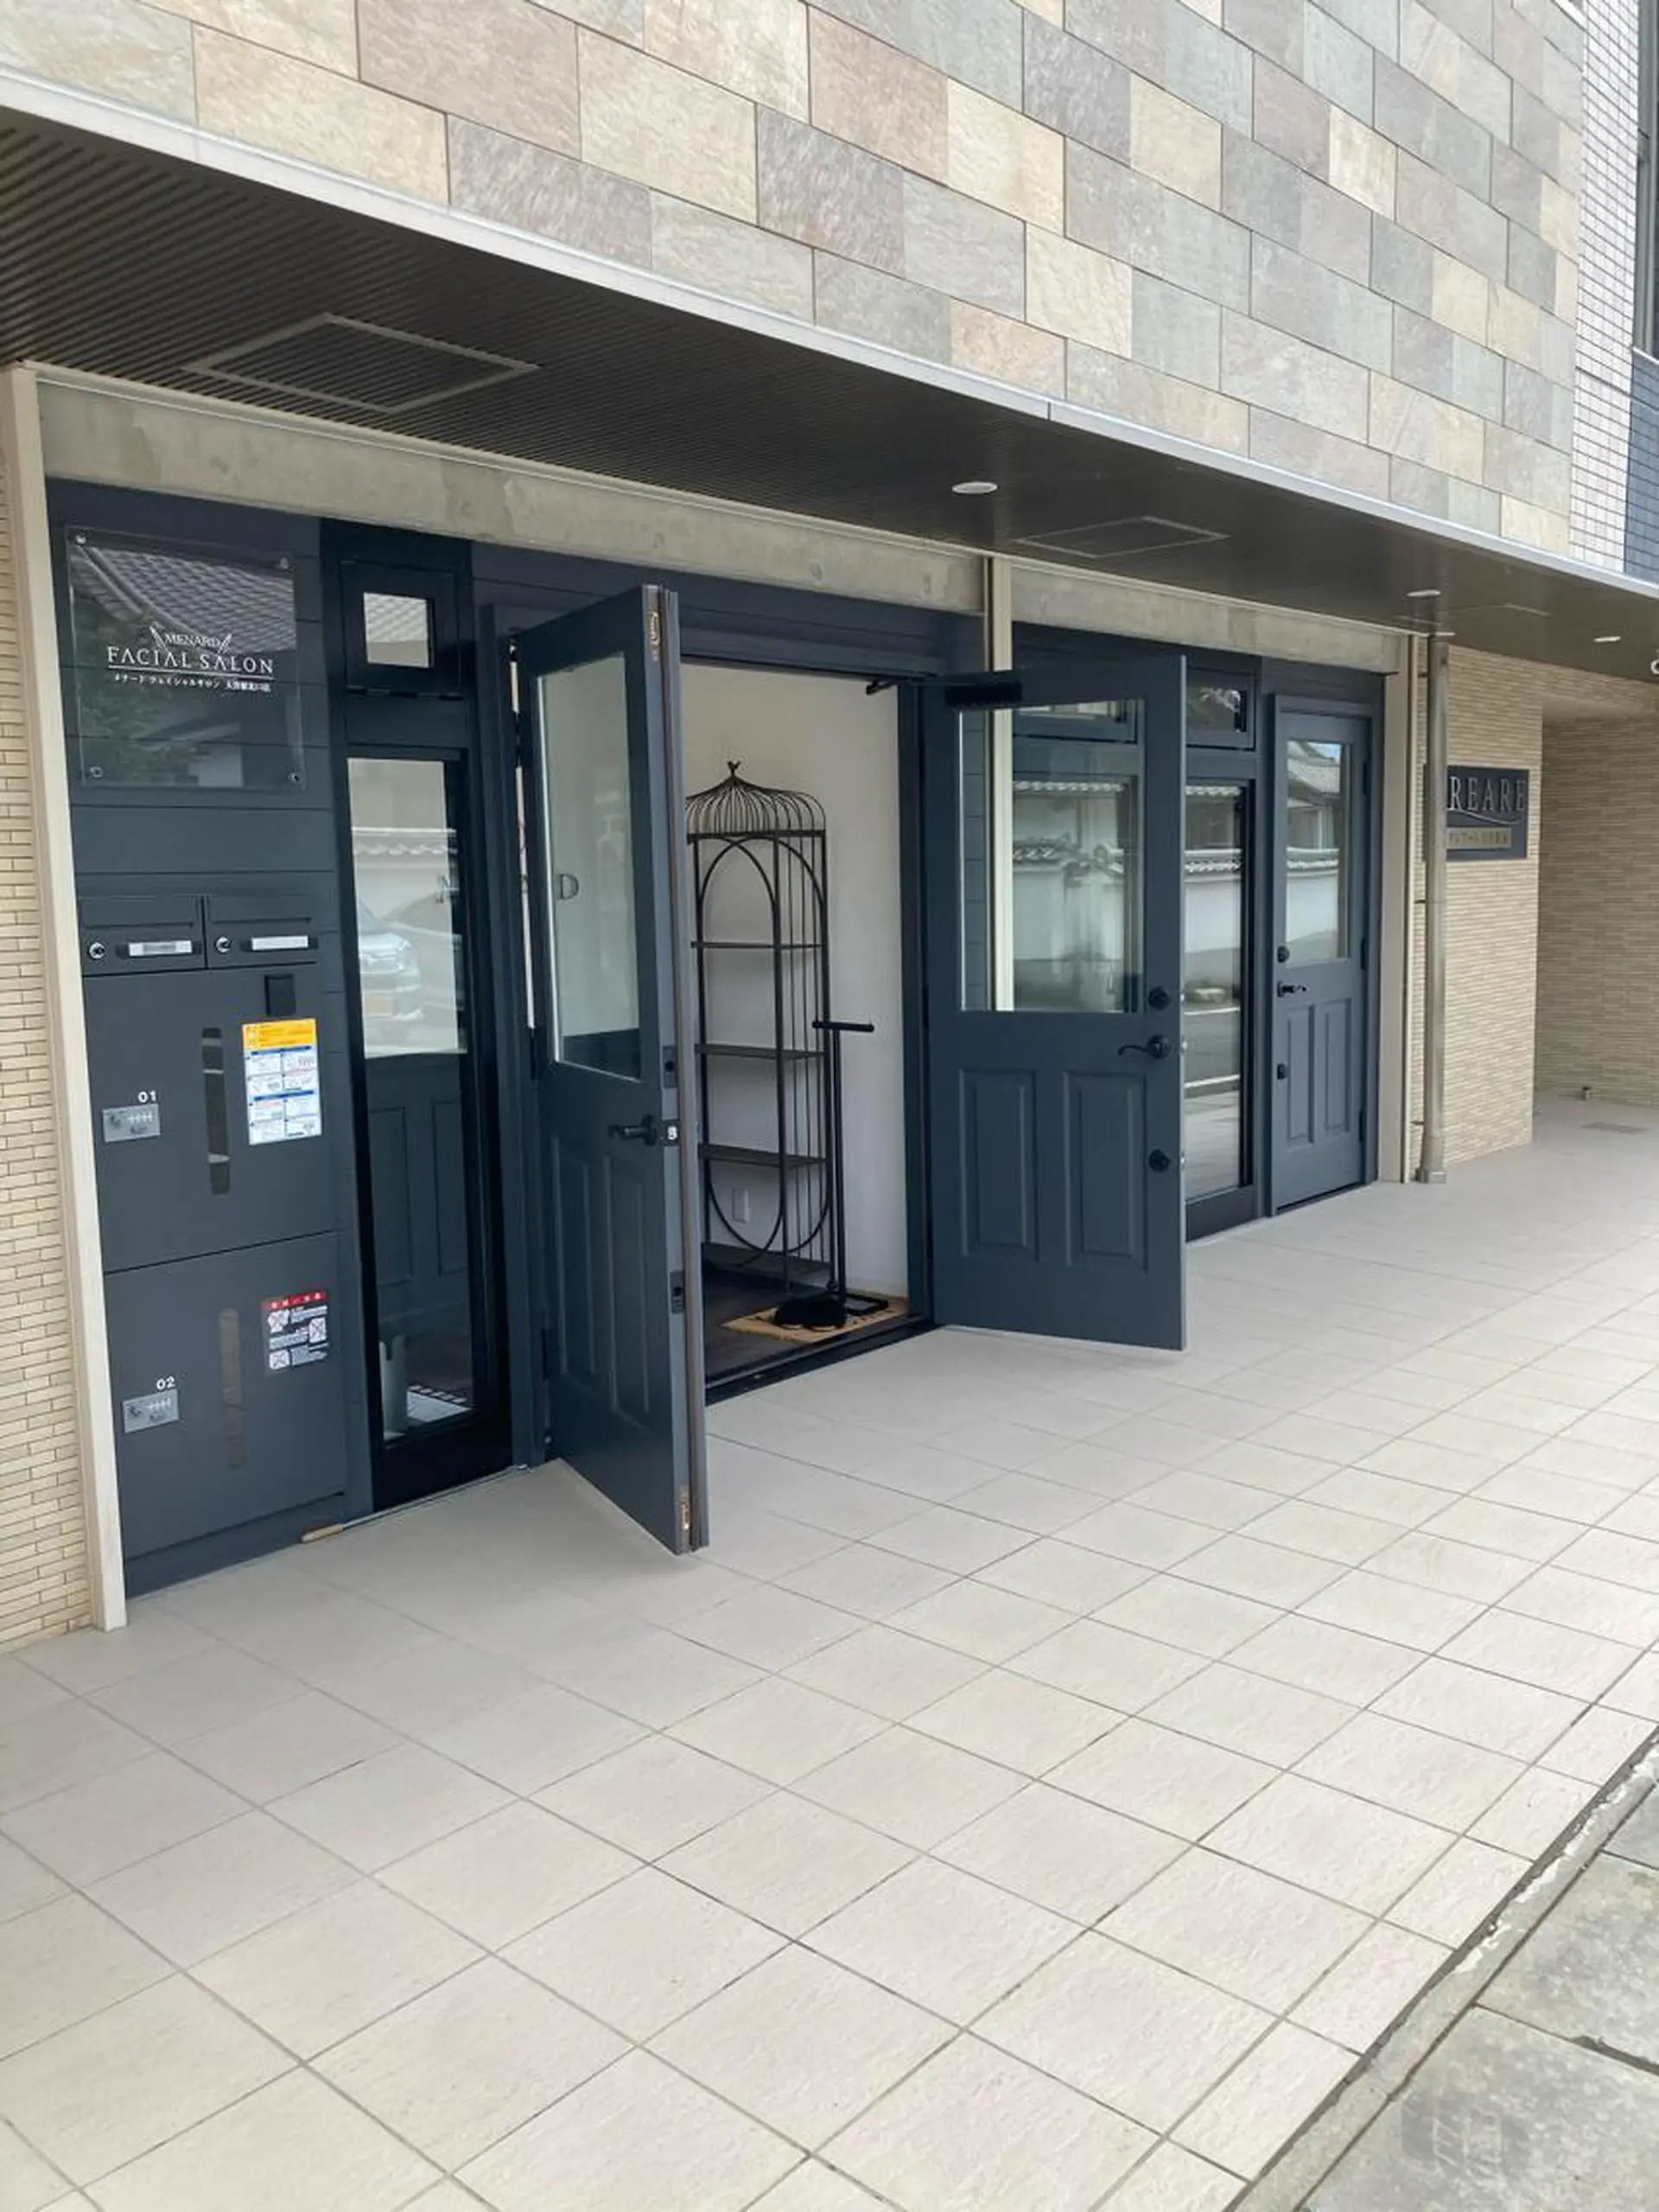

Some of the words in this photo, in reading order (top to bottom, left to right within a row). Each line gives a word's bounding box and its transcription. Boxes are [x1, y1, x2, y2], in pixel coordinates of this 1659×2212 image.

[164, 632, 220, 647] MENARD
[107, 645, 192, 668] FACIAL
[200, 652, 273, 674] SALON
[1448, 776, 1526, 811] REARE
[137, 1090, 156, 1103] 01
[156, 1376, 176, 1390] 02
